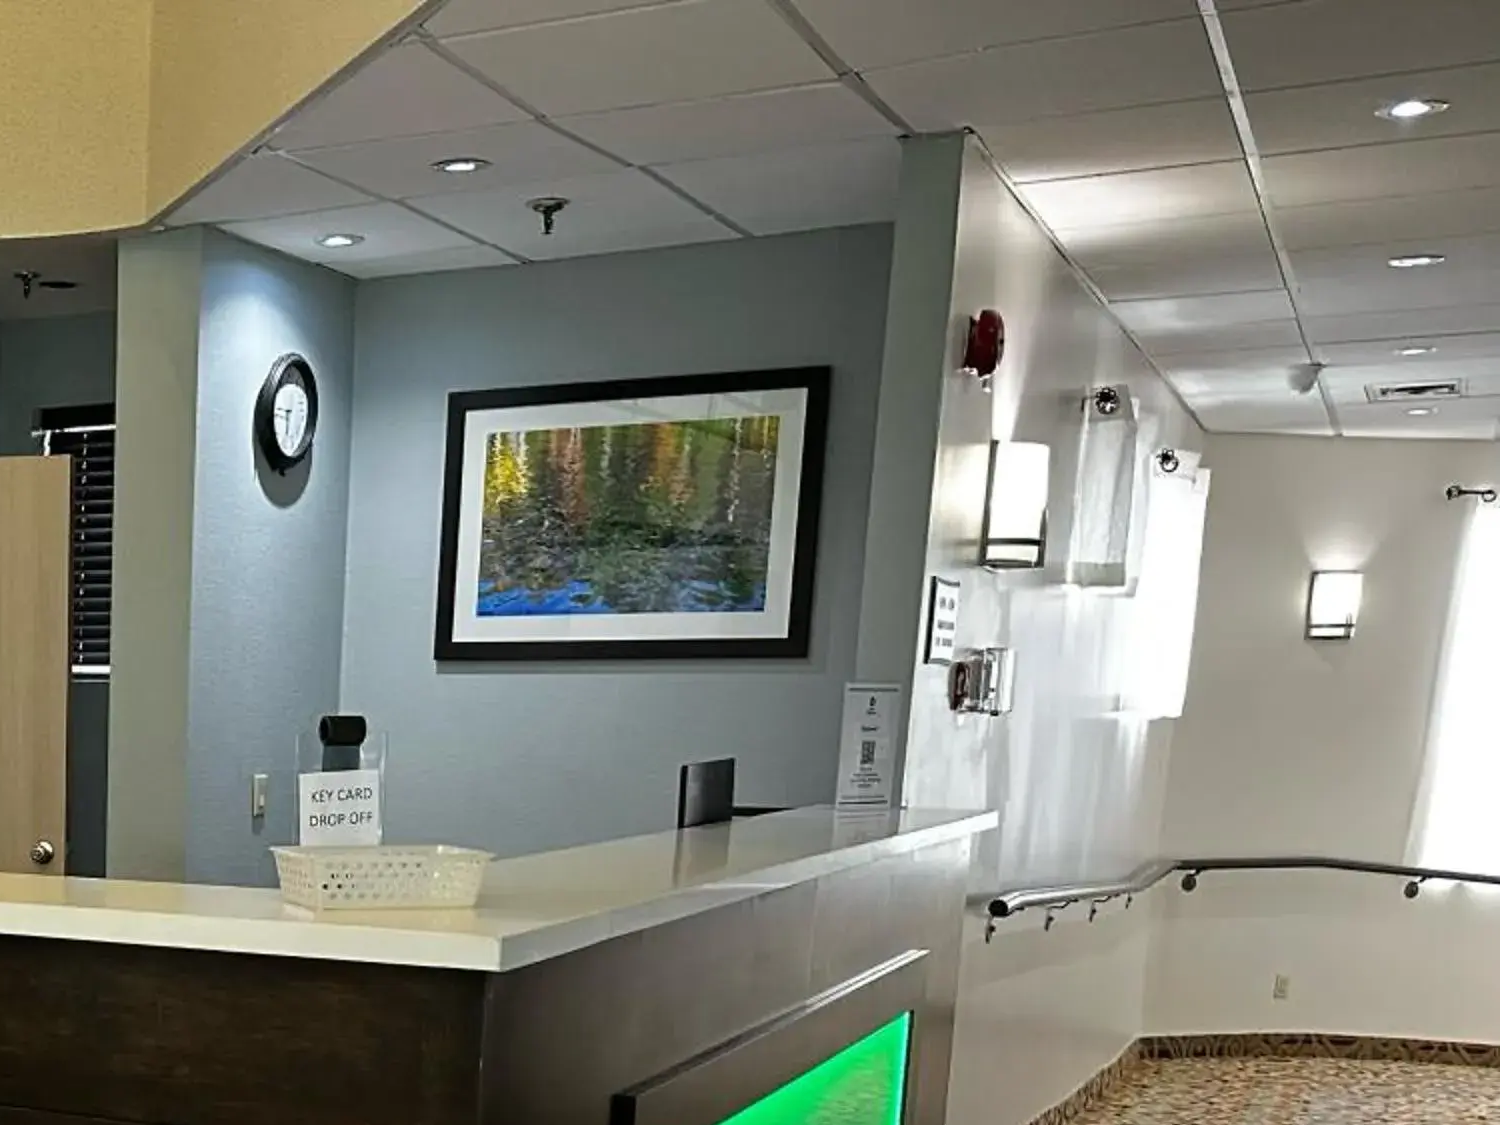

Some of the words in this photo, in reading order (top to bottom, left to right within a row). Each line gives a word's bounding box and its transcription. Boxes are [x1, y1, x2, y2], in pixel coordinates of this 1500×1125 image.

[311, 788, 333, 804] KEY
[337, 787, 373, 801] CARD
[308, 812, 345, 828] DROP
[349, 811, 374, 826] OFF
